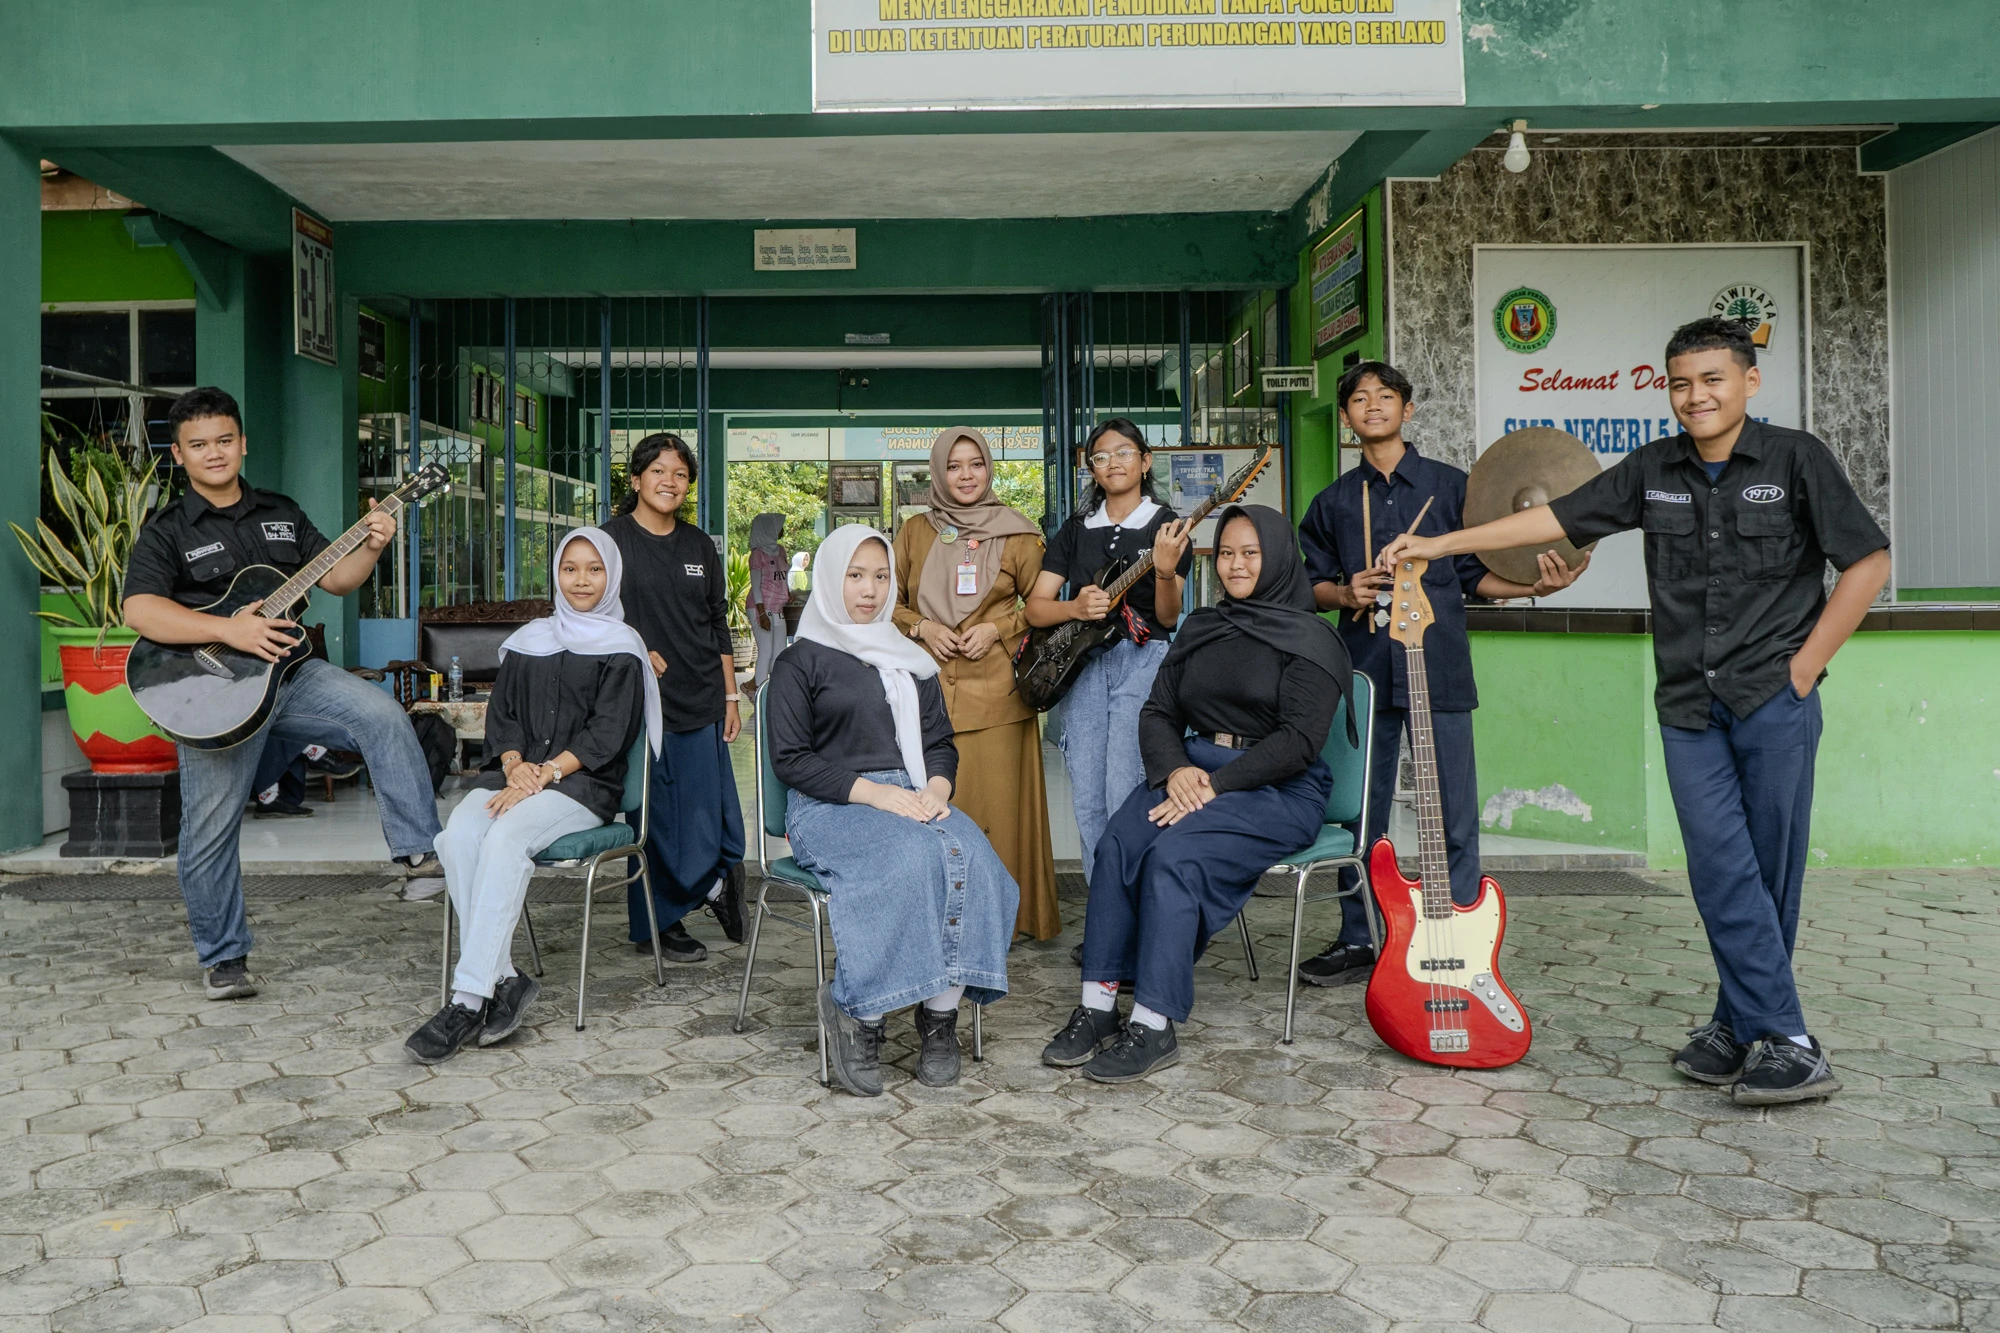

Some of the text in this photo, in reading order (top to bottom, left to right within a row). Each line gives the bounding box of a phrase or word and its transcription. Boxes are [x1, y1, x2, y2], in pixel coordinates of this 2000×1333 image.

[880, 0, 1090, 20] MENYELENGGARAKAN
[1094, 0, 1216, 16] PENDIDIKAN
[828, 20, 1446, 53] DI LUAR KETENTUAN PERATURAN PERUNDANGAN YANG BERLAKU
[1712, 286, 1777, 319] ADIWIYATA
[1522, 314, 1528, 322] 5
[1266, 377, 1309, 388] TOILET PUTRI
[1519, 367, 1620, 392] Selamat
[1564, 418, 1652, 453] NEGERI
[1747, 488, 1778, 500] 1979
